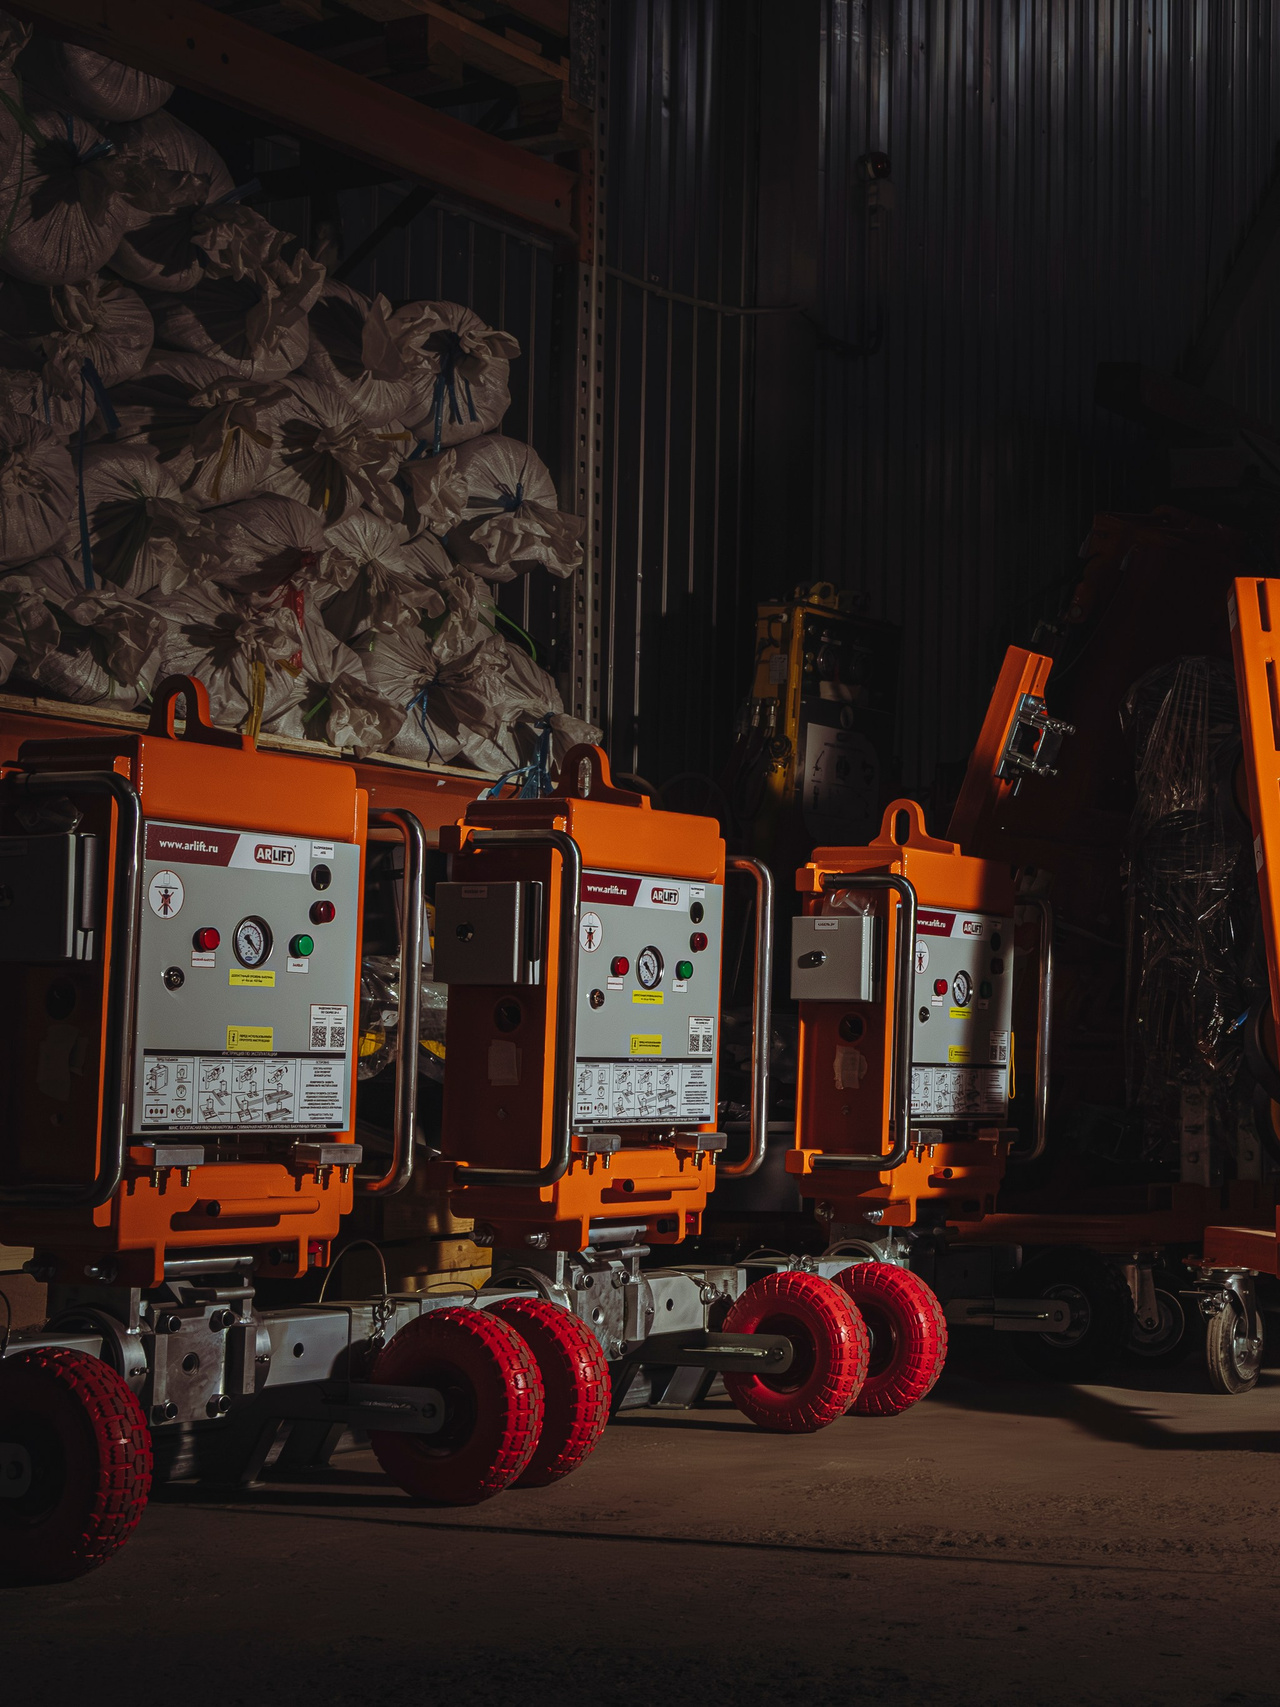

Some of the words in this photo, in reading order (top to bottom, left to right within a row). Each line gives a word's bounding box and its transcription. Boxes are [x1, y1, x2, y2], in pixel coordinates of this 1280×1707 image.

[159, 840, 218, 853] www.arlift.ru
[256, 846, 293, 863] ARLIFT
[587, 885, 627, 896] www.arlift.ru
[652, 889, 678, 903] ARLIFT
[963, 923, 982, 934] ARLIFT
